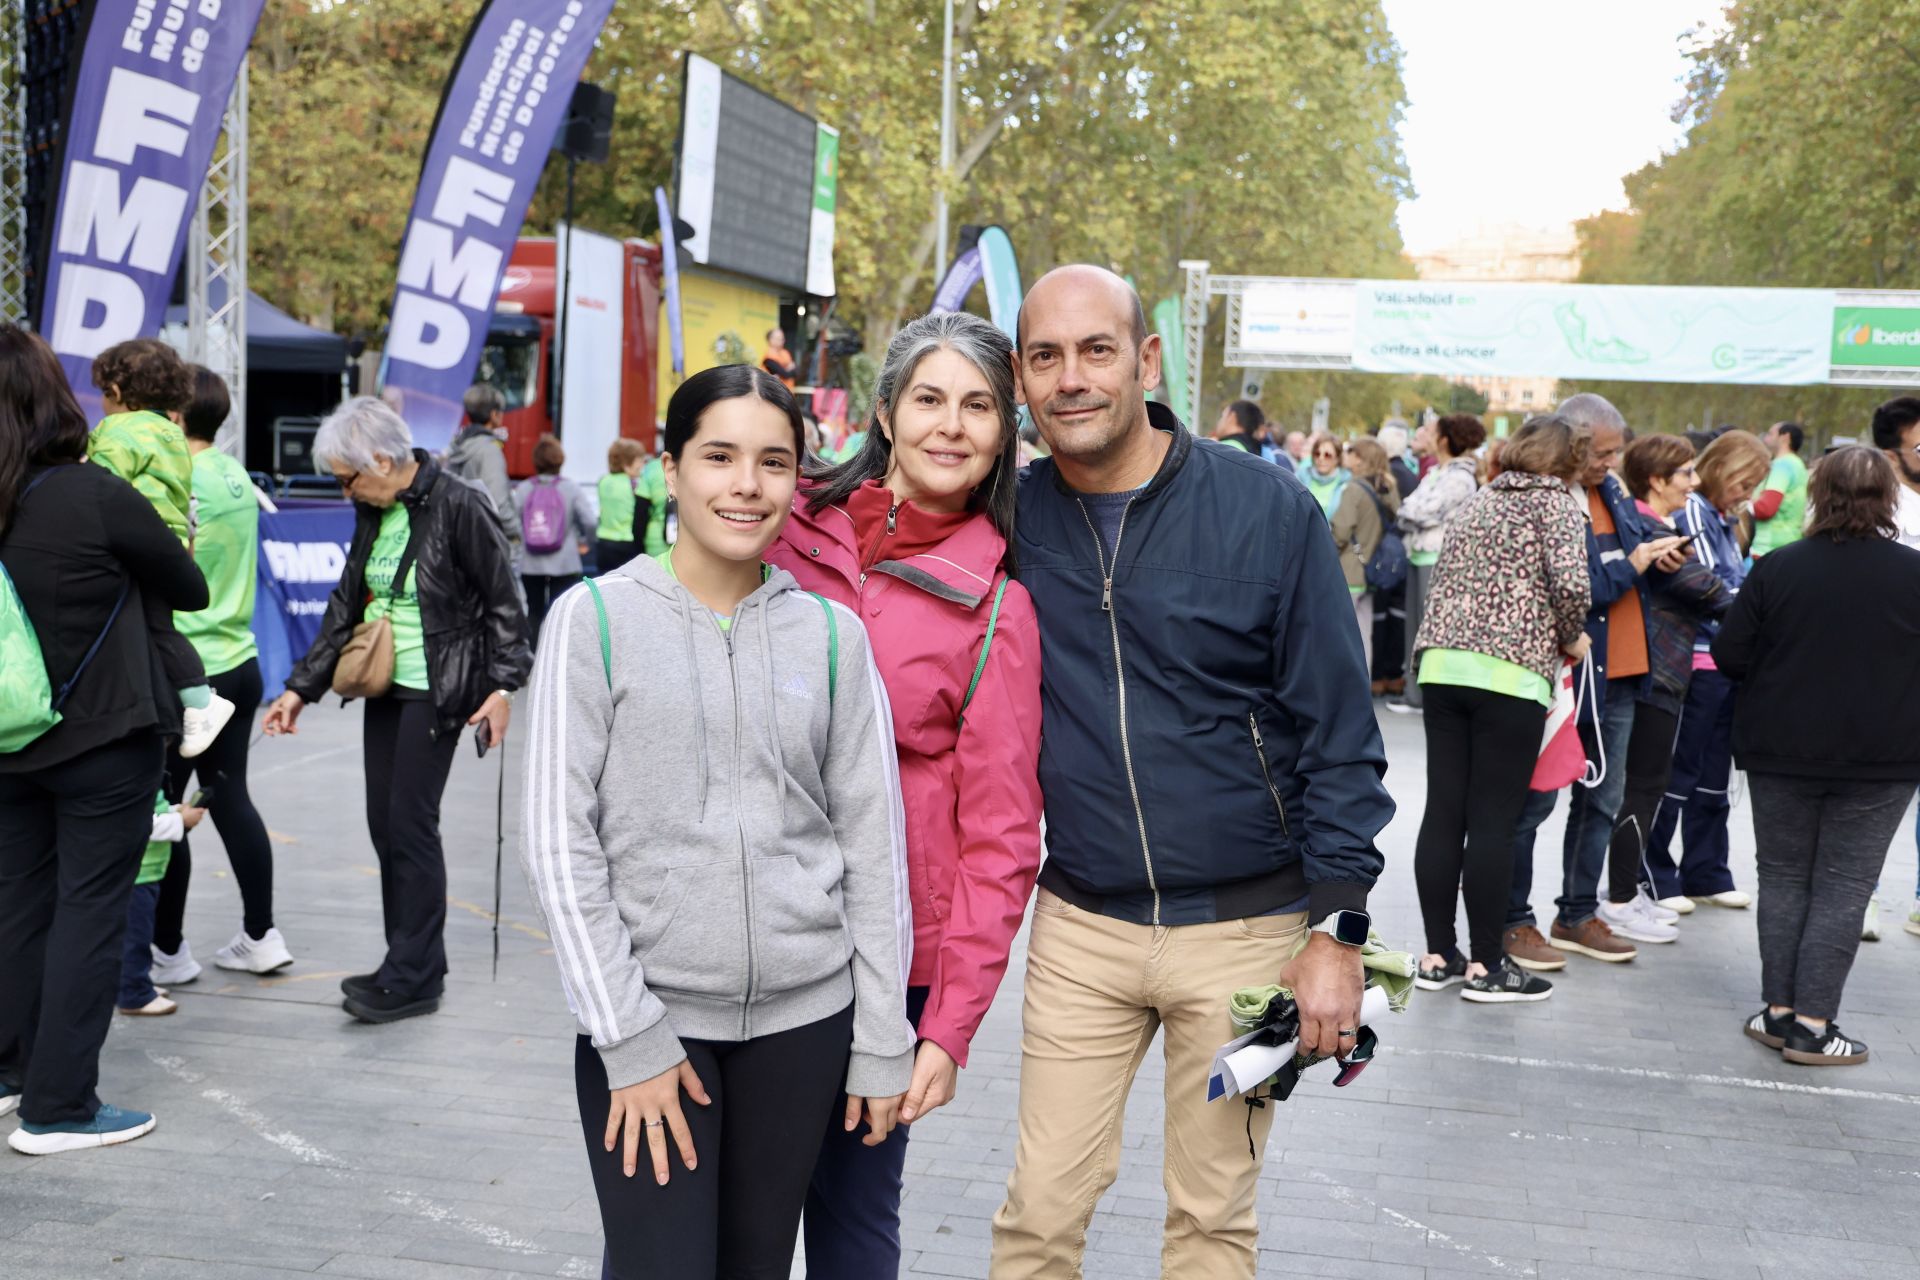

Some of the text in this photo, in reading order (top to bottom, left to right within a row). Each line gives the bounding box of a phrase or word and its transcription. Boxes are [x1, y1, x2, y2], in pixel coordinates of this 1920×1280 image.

[181, 27, 210, 73] de
[459, 18, 526, 149] Fundación
[479, 26, 545, 158] Municipal
[502, 0, 584, 165] de Deportes
[51, 66, 201, 360] FMD
[387, 154, 516, 370] FMD
[1370, 342, 1420, 356] contra
[262, 539, 347, 584] FMD
